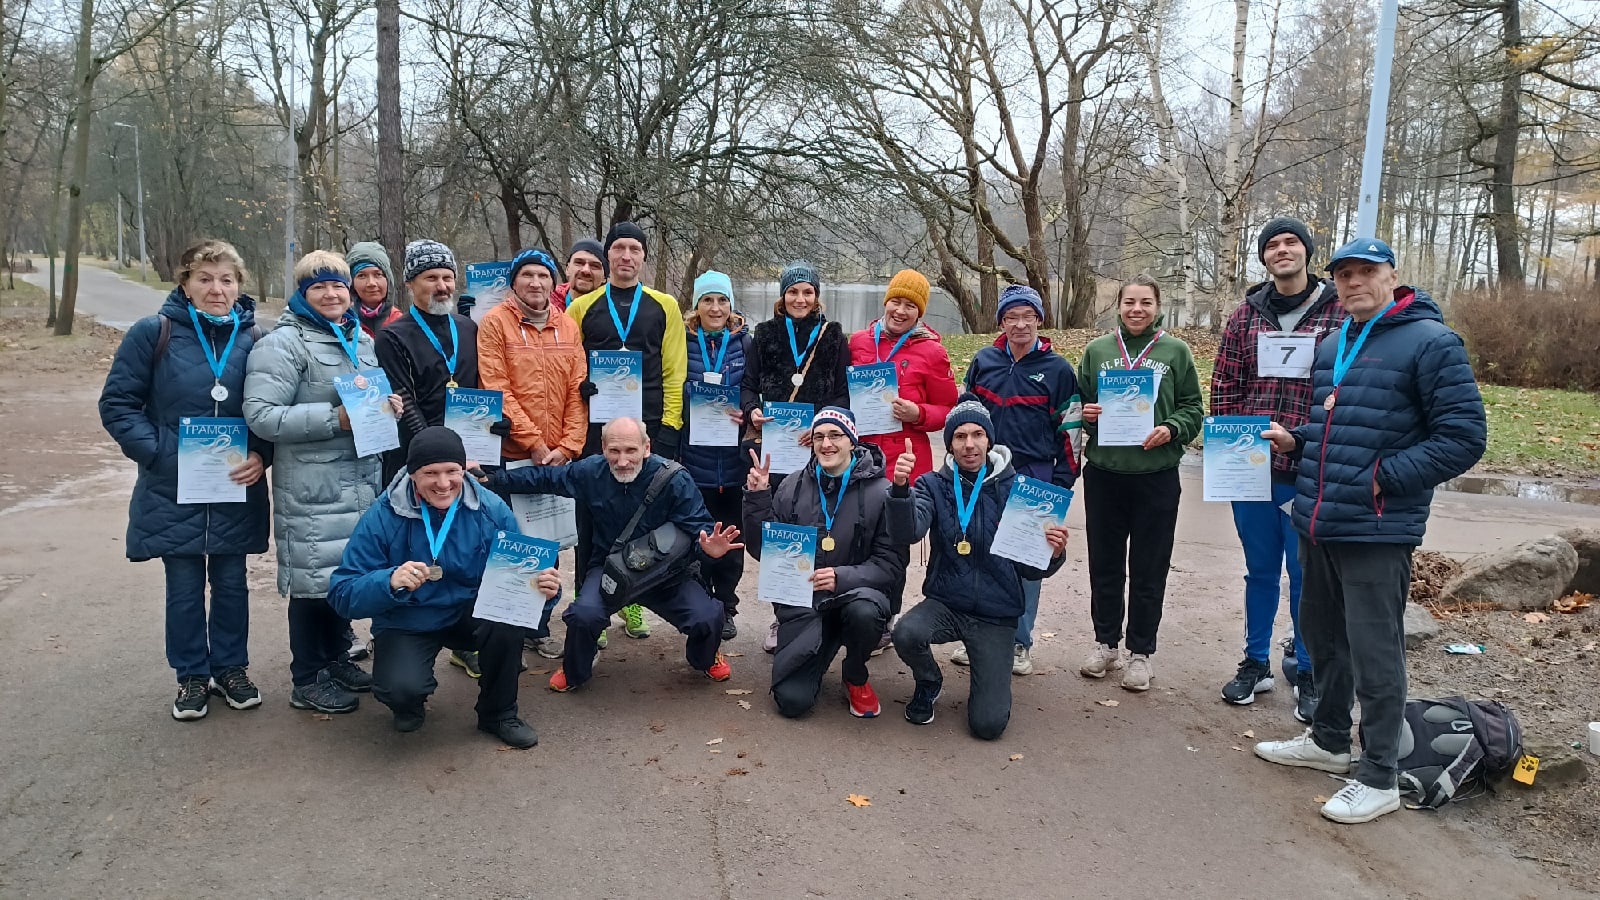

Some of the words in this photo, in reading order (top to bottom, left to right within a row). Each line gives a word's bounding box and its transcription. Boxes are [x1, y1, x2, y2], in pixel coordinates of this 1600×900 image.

[470, 267, 511, 279] ГРАМОТА
[594, 356, 637, 366] ГРАМОТА
[1280, 346, 1297, 365] 7
[1100, 360, 1113, 371] ST.
[1114, 357, 1170, 375] PESBURG
[851, 368, 891, 379] ГРАМОТА
[1102, 376, 1147, 386] ГРАМОТА
[695, 385, 735, 396] ГРАМОТА
[451, 394, 496, 405] ГРАМОТА
[768, 407, 808, 418] ГРАМОТА
[185, 425, 240, 435] ГРАМОТА
[1210, 424, 1262, 434] ГРАМОТА
[1017, 482, 1063, 504] ГРАМОТА
[766, 529, 811, 543] ГРАМОТА
[497, 539, 550, 559] ГРАМОТА
